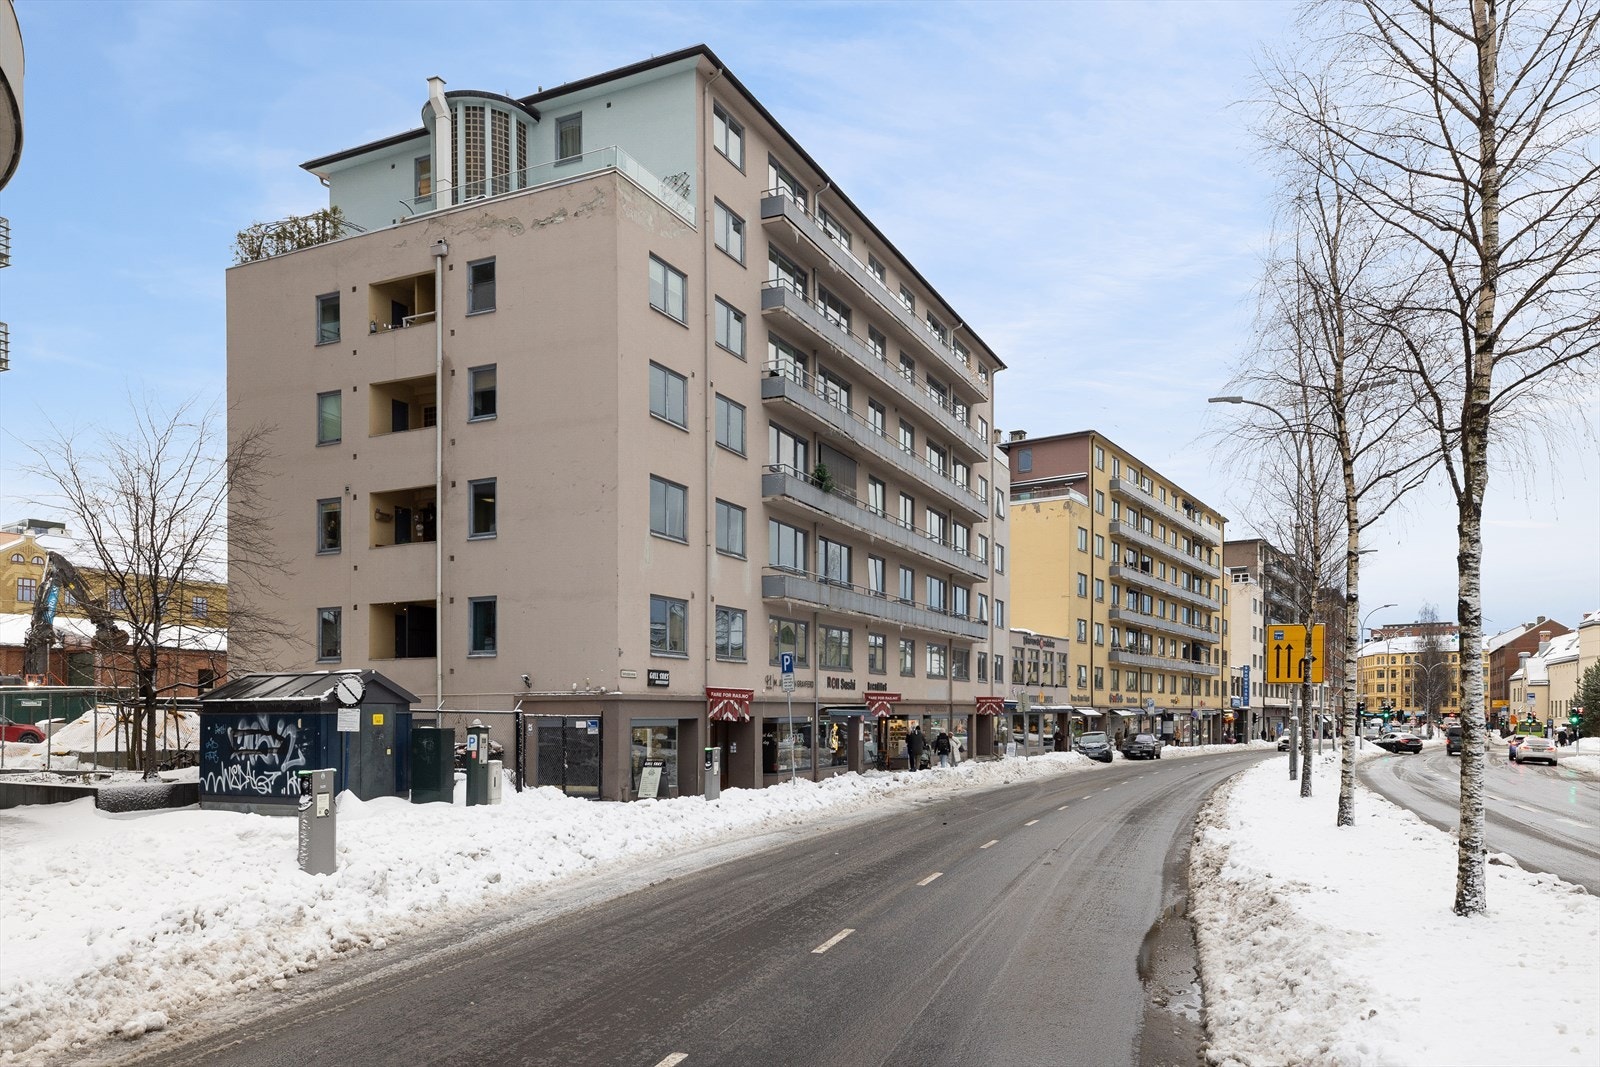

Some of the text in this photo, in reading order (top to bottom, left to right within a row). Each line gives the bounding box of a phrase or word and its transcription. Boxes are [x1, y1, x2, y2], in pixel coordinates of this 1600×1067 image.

[783, 655, 790, 671] P
[840, 678, 856, 690] Sushi
[469, 737, 475, 747] P
